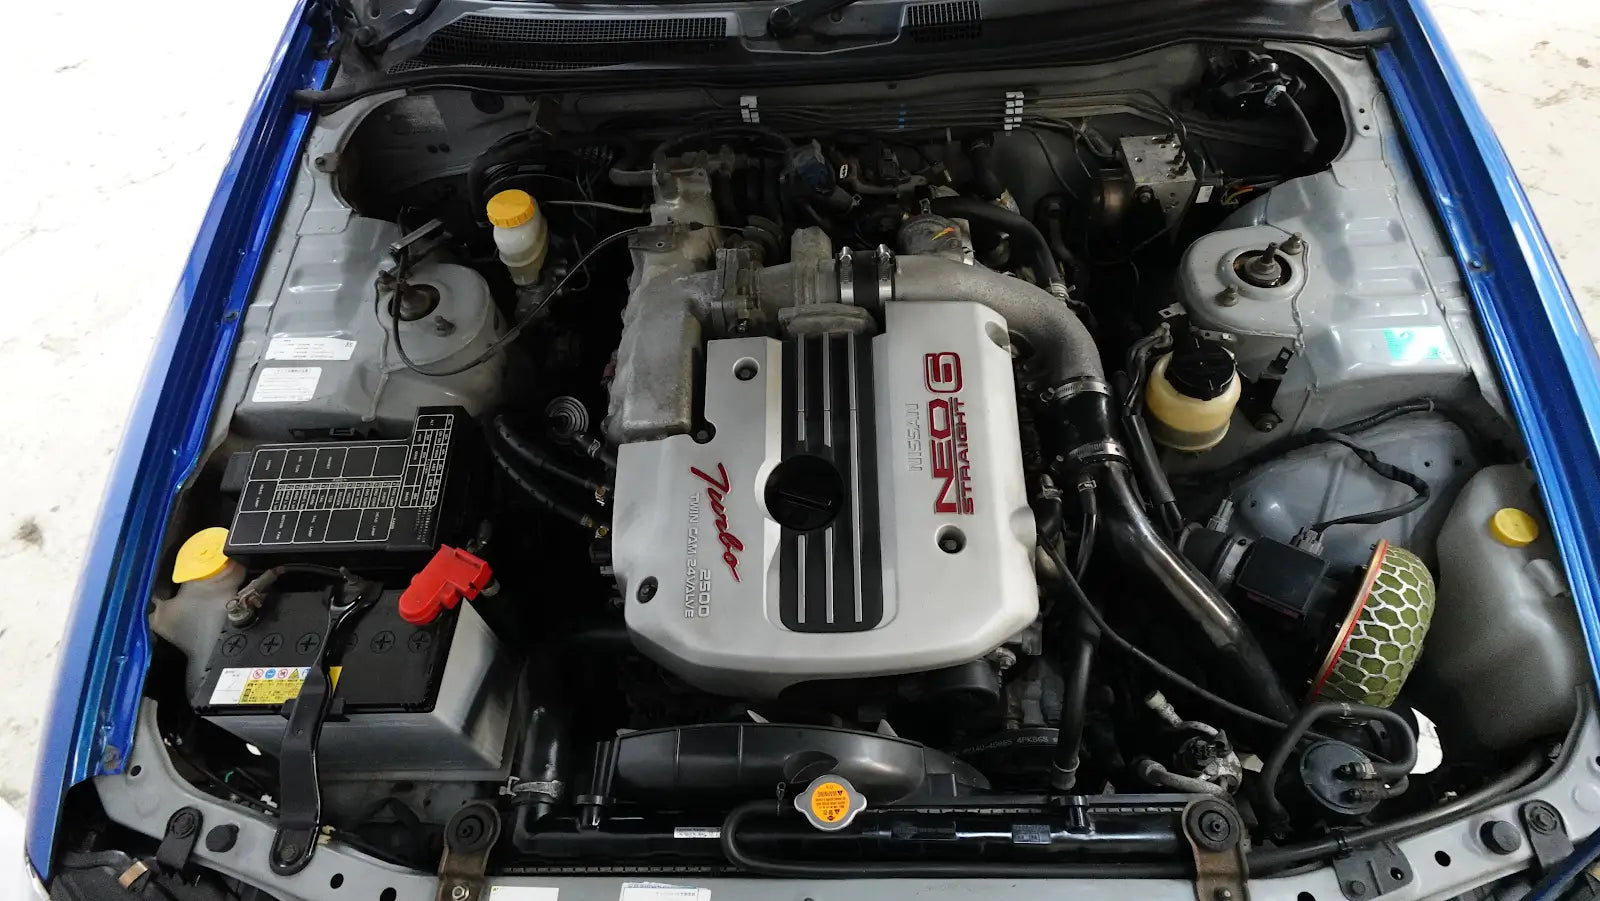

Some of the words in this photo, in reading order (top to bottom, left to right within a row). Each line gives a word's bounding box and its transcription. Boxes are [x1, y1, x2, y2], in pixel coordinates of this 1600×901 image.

[923, 351, 964, 394] 6
[905, 403, 923, 472] NISSAN
[927, 398, 958, 514] NEO
[955, 400, 975, 515] STRAIGHT
[688, 492, 700, 524] TWIN
[690, 462, 746, 583] Turbo
[686, 527, 698, 554] CAM
[684, 559, 697, 619] 24VALVE
[698, 569, 712, 618] 2500
